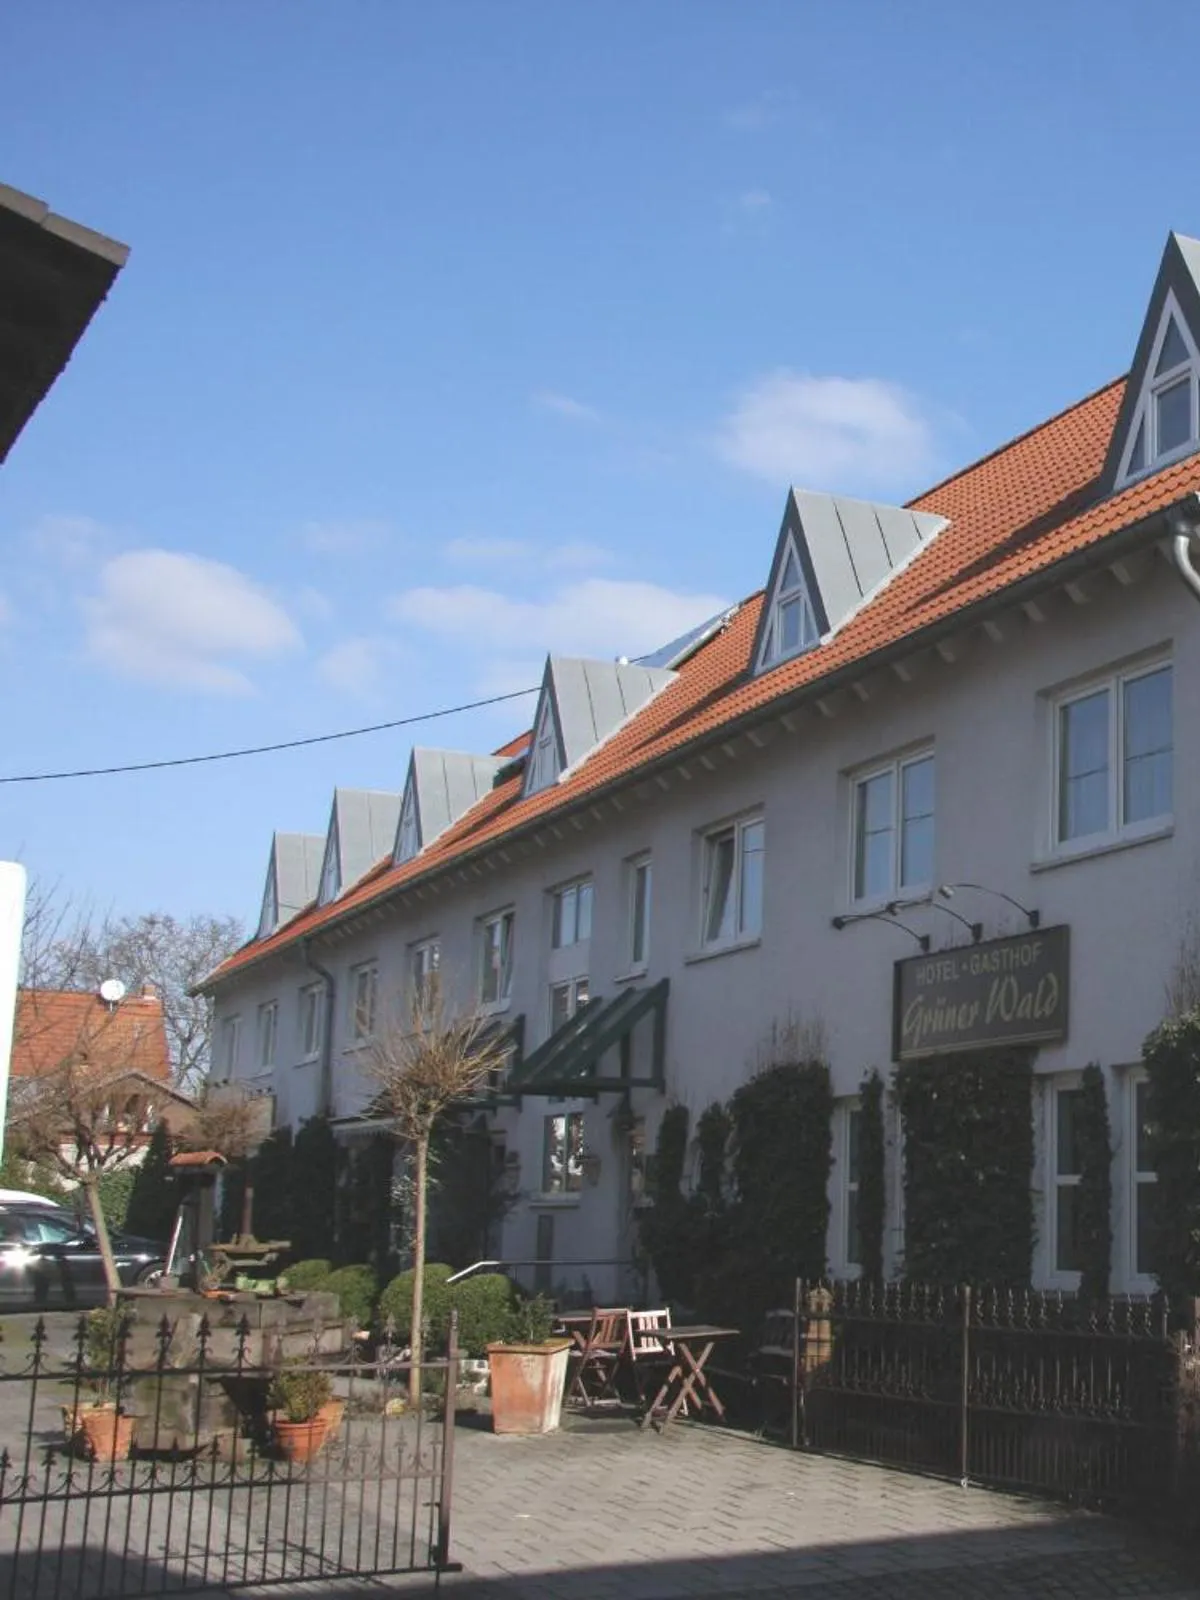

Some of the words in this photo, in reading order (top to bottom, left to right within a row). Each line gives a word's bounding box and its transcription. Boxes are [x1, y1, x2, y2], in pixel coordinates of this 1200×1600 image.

[916, 960, 960, 986] HOTEL
[969, 942, 1043, 975] GASTHOF
[902, 995, 980, 1048] Grüner
[985, 972, 1059, 1024] Wald
